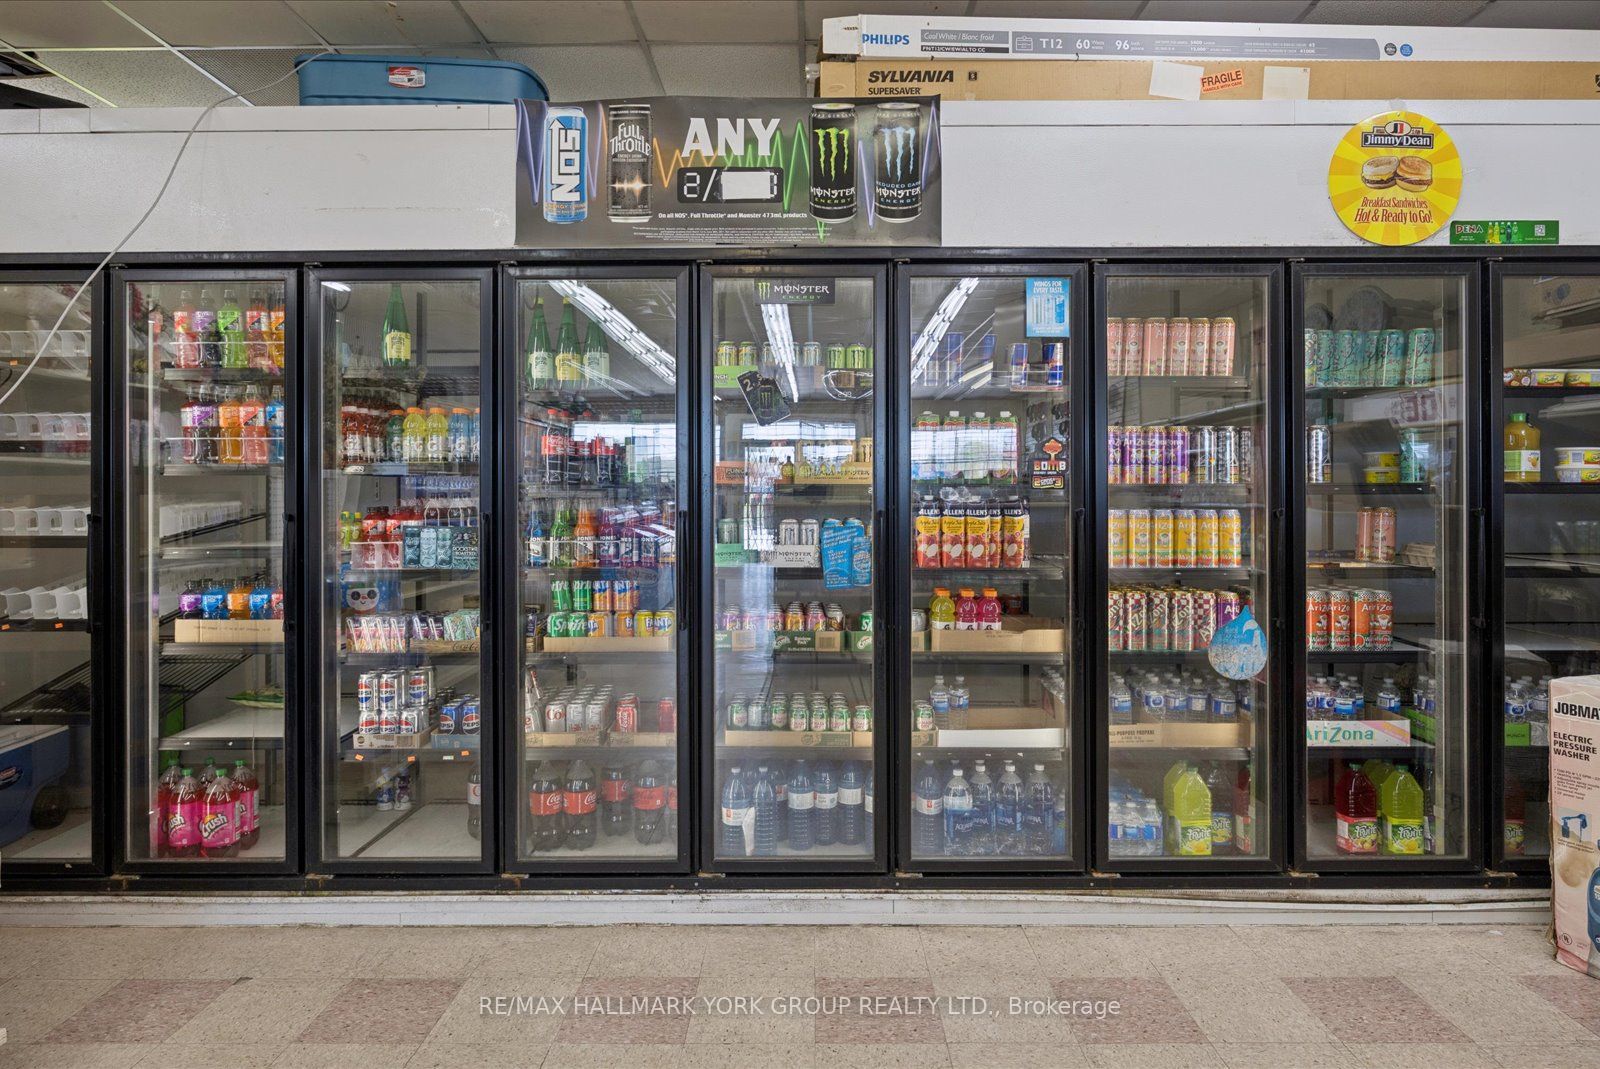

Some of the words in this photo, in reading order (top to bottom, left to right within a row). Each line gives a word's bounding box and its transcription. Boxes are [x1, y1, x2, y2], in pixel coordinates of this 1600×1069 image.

[862, 33, 910, 45] PHILIPS
[1039, 38, 1063, 49] T12
[1075, 39, 1091, 49] 60
[1115, 39, 1130, 50] 96
[868, 70, 954, 83] SYLVANIA
[1201, 70, 1243, 88] FRAGILE
[868, 87, 921, 95] SUPERSAVER
[617, 122, 641, 141] Full
[681, 117, 781, 158] ANY
[609, 135, 651, 157] Throttle
[1365, 133, 1402, 147] Jimmy
[1403, 135, 1431, 146] Dean
[550, 119, 581, 202] NOS
[810, 185, 856, 199] MONSTER
[876, 186, 921, 199] MONSTER
[1361, 197, 1391, 208] Breakfast
[1391, 197, 1429, 209] Sandwiches
[783, 212, 808, 220] products
[1354, 208, 1371, 223] Hot
[1371, 210, 1380, 222] &
[1380, 209, 1408, 225] Ready
[1409, 210, 1418, 223] to
[1418, 210, 1433, 224] Go!
[773, 282, 830, 294] MONSTER
[1033, 460, 1066, 472] BOMB
[1554, 702, 1600, 721] JOBMA
[1306, 725, 1375, 744] AriZona
[1553, 731, 1593, 746] ELECTRIC
[1553, 739, 1598, 755] PRESSURE
[1553, 747, 1590, 762] WASHER
[201, 813, 228, 840] Crush
